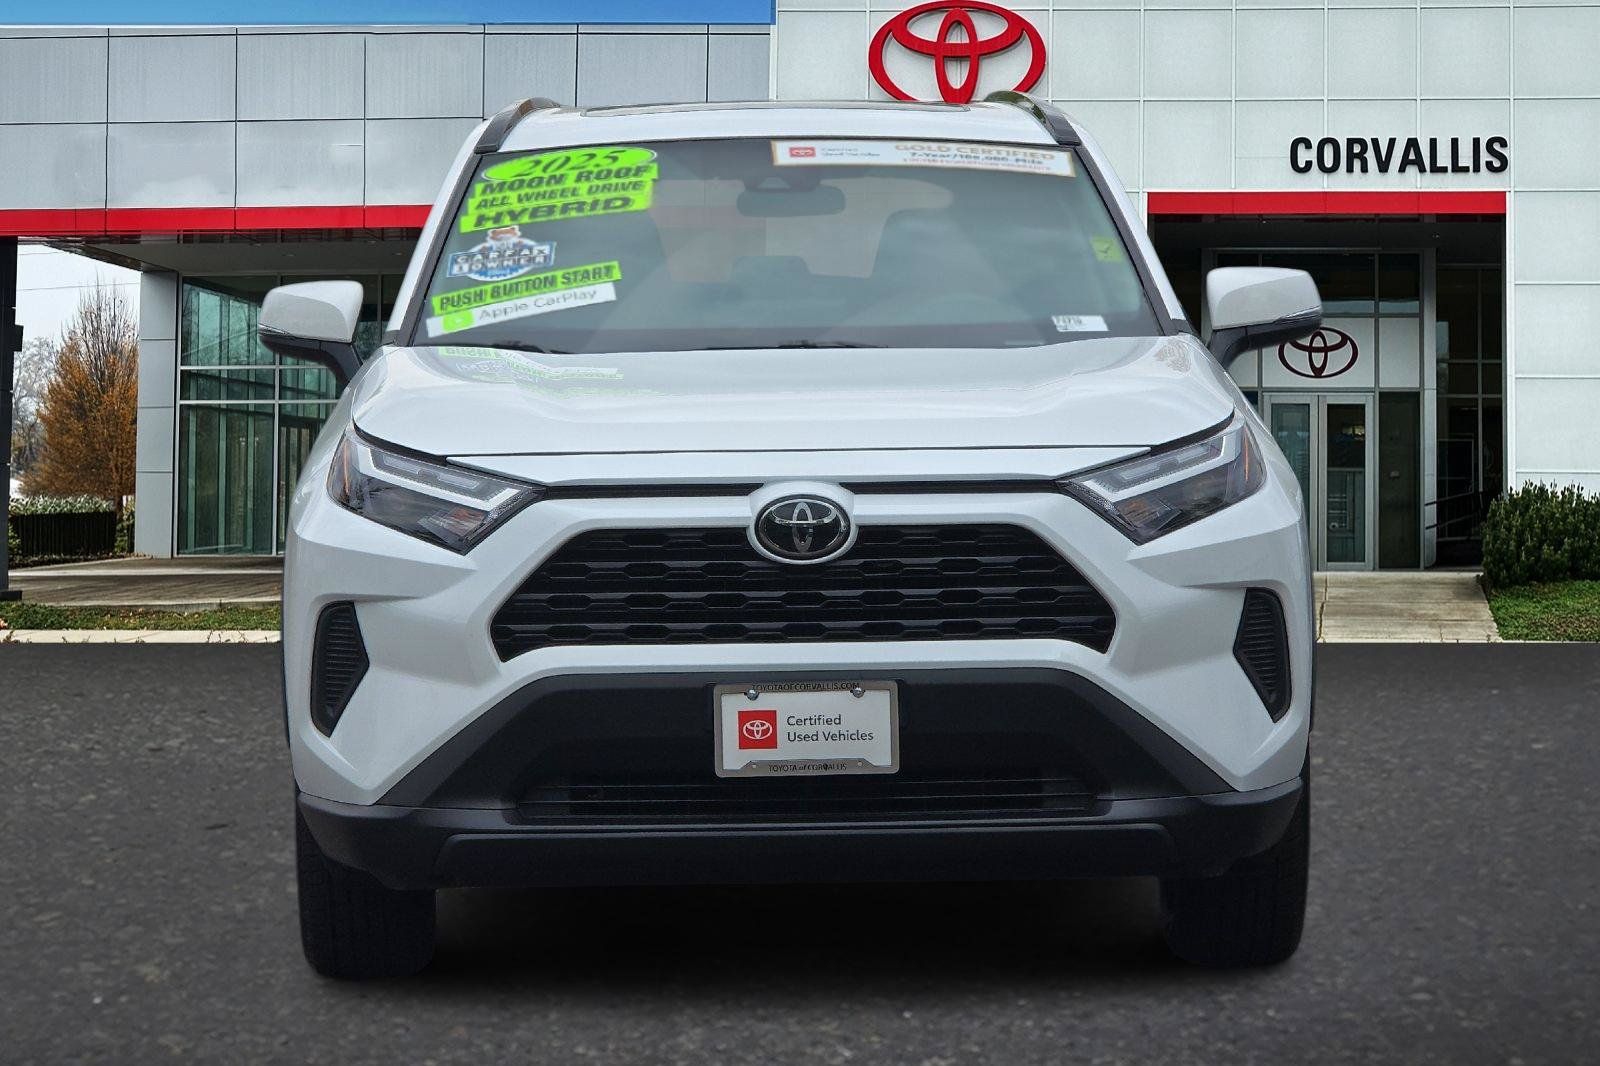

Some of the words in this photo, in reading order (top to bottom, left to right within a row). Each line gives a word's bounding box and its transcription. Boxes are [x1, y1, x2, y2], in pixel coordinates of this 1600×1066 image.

[512, 149, 627, 178] 2025
[895, 143, 951, 153] GOLD
[956, 145, 1055, 161] CERTIFIED
[1290, 137, 1508, 173] CORVALLIS
[475, 194, 511, 210] ALL
[517, 186, 581, 204] WHEEL
[587, 180, 645, 195] DRIVE
[480, 173, 566, 196] MOON
[574, 165, 651, 183] ROOF
[473, 197, 634, 228] HYBRID
[456, 248, 548, 263] CARFAX
[472, 256, 545, 270] OWNER
[440, 290, 484, 312] PUSH
[490, 276, 557, 298] BUTTON
[560, 265, 616, 286] START
[479, 302, 528, 321] Apple
[534, 289, 598, 308] CarPlay
[786, 714, 842, 726] Certified
[787, 731, 819, 742] Used
[822, 730, 874, 742] Vehicles
[768, 764, 797, 772] TOYOTA
[807, 763, 847, 771] CORVALLIS
